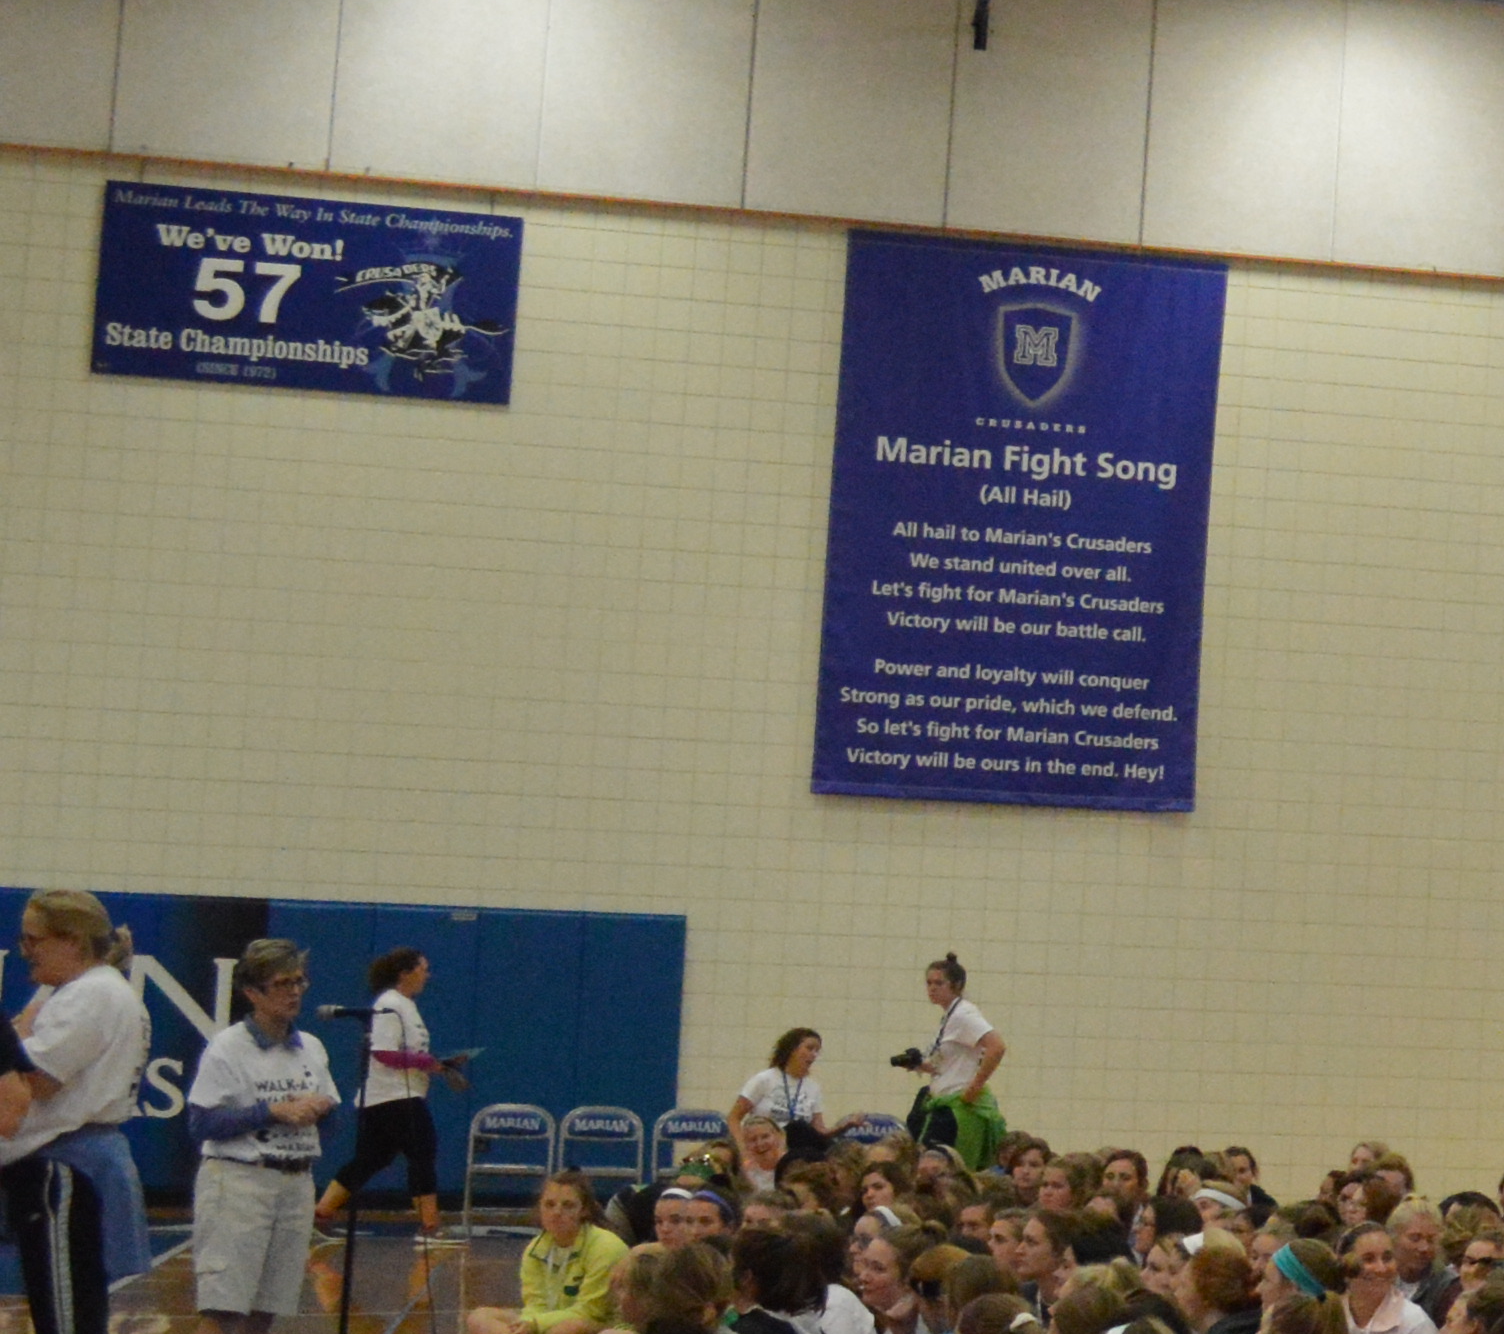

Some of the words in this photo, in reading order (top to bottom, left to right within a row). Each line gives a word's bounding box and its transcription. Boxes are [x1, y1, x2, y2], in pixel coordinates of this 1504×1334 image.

[117, 190, 178, 207] Marian
[184, 196, 232, 213] Leads
[239, 200, 269, 216] The
[275, 203, 312, 223] Way
[315, 207, 334, 222] In
[338, 209, 381, 227] State
[384, 213, 514, 241] Championships.
[156, 224, 251, 253] We've
[261, 233, 344, 261] Won!
[191, 257, 302, 324] 57
[978, 266, 1102, 302] MARIAN
[105, 322, 172, 350] State
[179, 328, 369, 369] Championships
[975, 417, 1087, 434] CRUSADERS
[876, 436, 992, 469] Marian
[1003, 445, 1087, 481] Fight
[1096, 452, 1177, 490] Song
[979, 484, 1017, 505] (All
[1023, 488, 1072, 511] Hail)
[892, 521, 918, 538] All
[922, 522, 956, 540] hail
[960, 527, 980, 542] to
[985, 527, 1062, 547] Marian's
[1066, 533, 1152, 554] Crusaders
[909, 552, 940, 569] We
[943, 557, 994, 573] stand
[999, 559, 1057, 577] united
[1061, 565, 1102, 580] over
[1105, 565, 1131, 582] all.
[871, 580, 913, 598] Let's
[917, 581, 962, 603] fight
[966, 585, 994, 602] for
[997, 588, 1075, 608] Marian's
[1079, 593, 1164, 614] Crusaders
[887, 611, 951, 634] Victory
[955, 615, 989, 632] will
[993, 616, 1016, 634] be
[1020, 622, 1052, 636] our
[1056, 621, 1109, 640] battle
[1112, 626, 1146, 642] call.
[874, 658, 932, 677] Power
[936, 663, 971, 679] and
[975, 664, 1037, 687] loyalty
[1041, 669, 1074, 685] will
[1078, 674, 1150, 692] conquer
[840, 686, 900, 709] Strong
[904, 693, 925, 707] as
[929, 695, 962, 708] our
[965, 694, 1017, 714] pride,
[1021, 697, 1075, 716] which
[1080, 704, 1108, 718] we
[1111, 702, 1178, 722] defend.
[856, 717, 879, 734] So
[884, 718, 922, 737] let's
[926, 720, 971, 742] fight
[974, 724, 1002, 741] for
[1006, 726, 1069, 745] Marian
[1074, 730, 1159, 751] Crusaders
[846, 747, 912, 770] Victory
[915, 751, 949, 768] will
[953, 752, 976, 770] be
[980, 758, 1020, 772] ours
[1024, 757, 1042, 773] in
[1046, 758, 1076, 775] the
[1081, 761, 1119, 777] end.
[1124, 763, 1165, 783] Hey!
[484, 1115, 540, 1130] MARIAN
[574, 1118, 629, 1133] MARIAN
[668, 1120, 722, 1134] MARIAN
